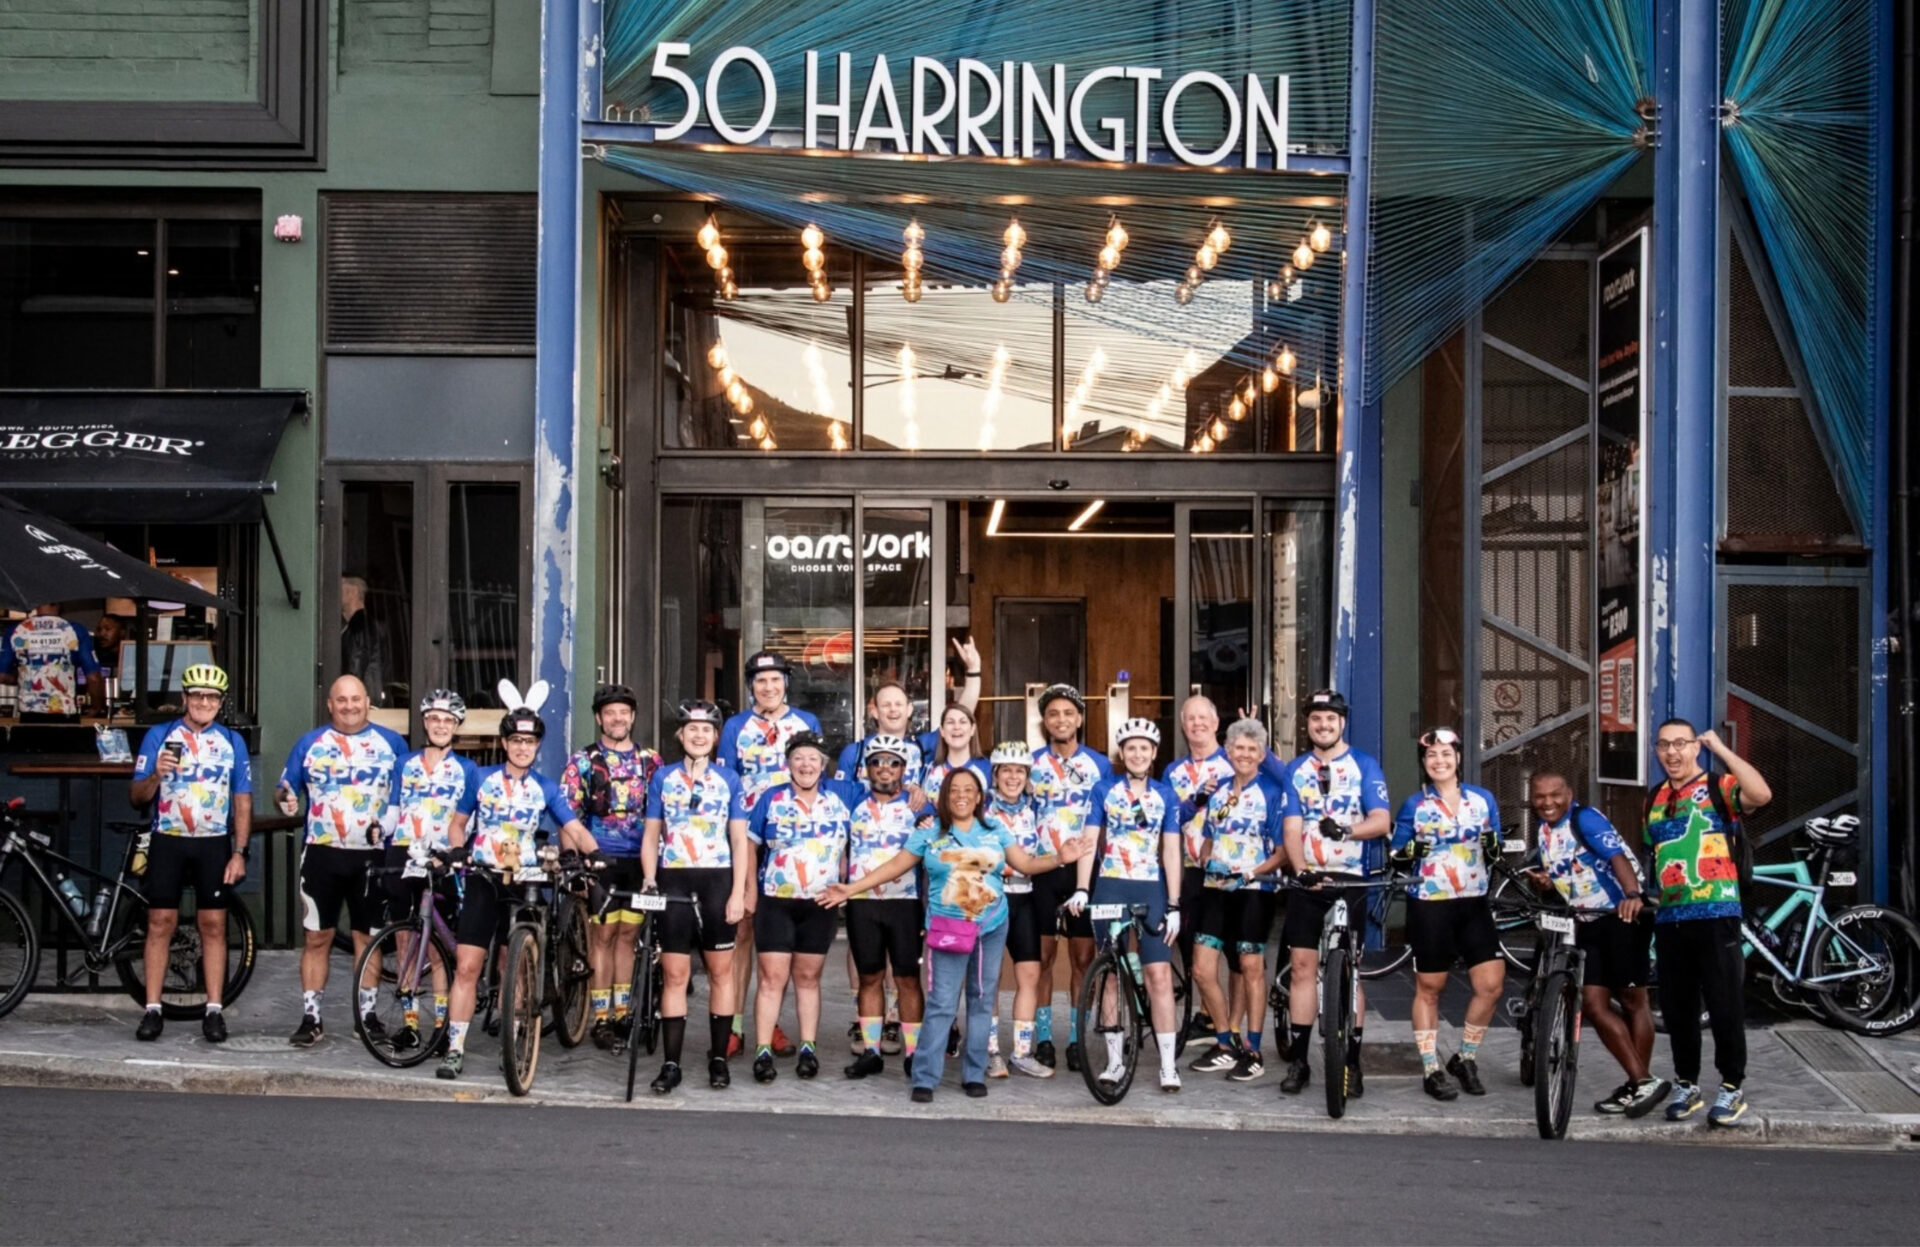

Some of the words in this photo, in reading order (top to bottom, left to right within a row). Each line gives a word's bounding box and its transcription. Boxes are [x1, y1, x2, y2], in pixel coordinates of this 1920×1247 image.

[650, 41, 777, 146] 50
[803, 49, 1290, 171] HARRINGTON
[0, 430, 192, 456] EGGER
[791, 564, 833, 573] CHOOSE
[868, 564, 902, 572] SPACE
[776, 820, 848, 840] SPCA
